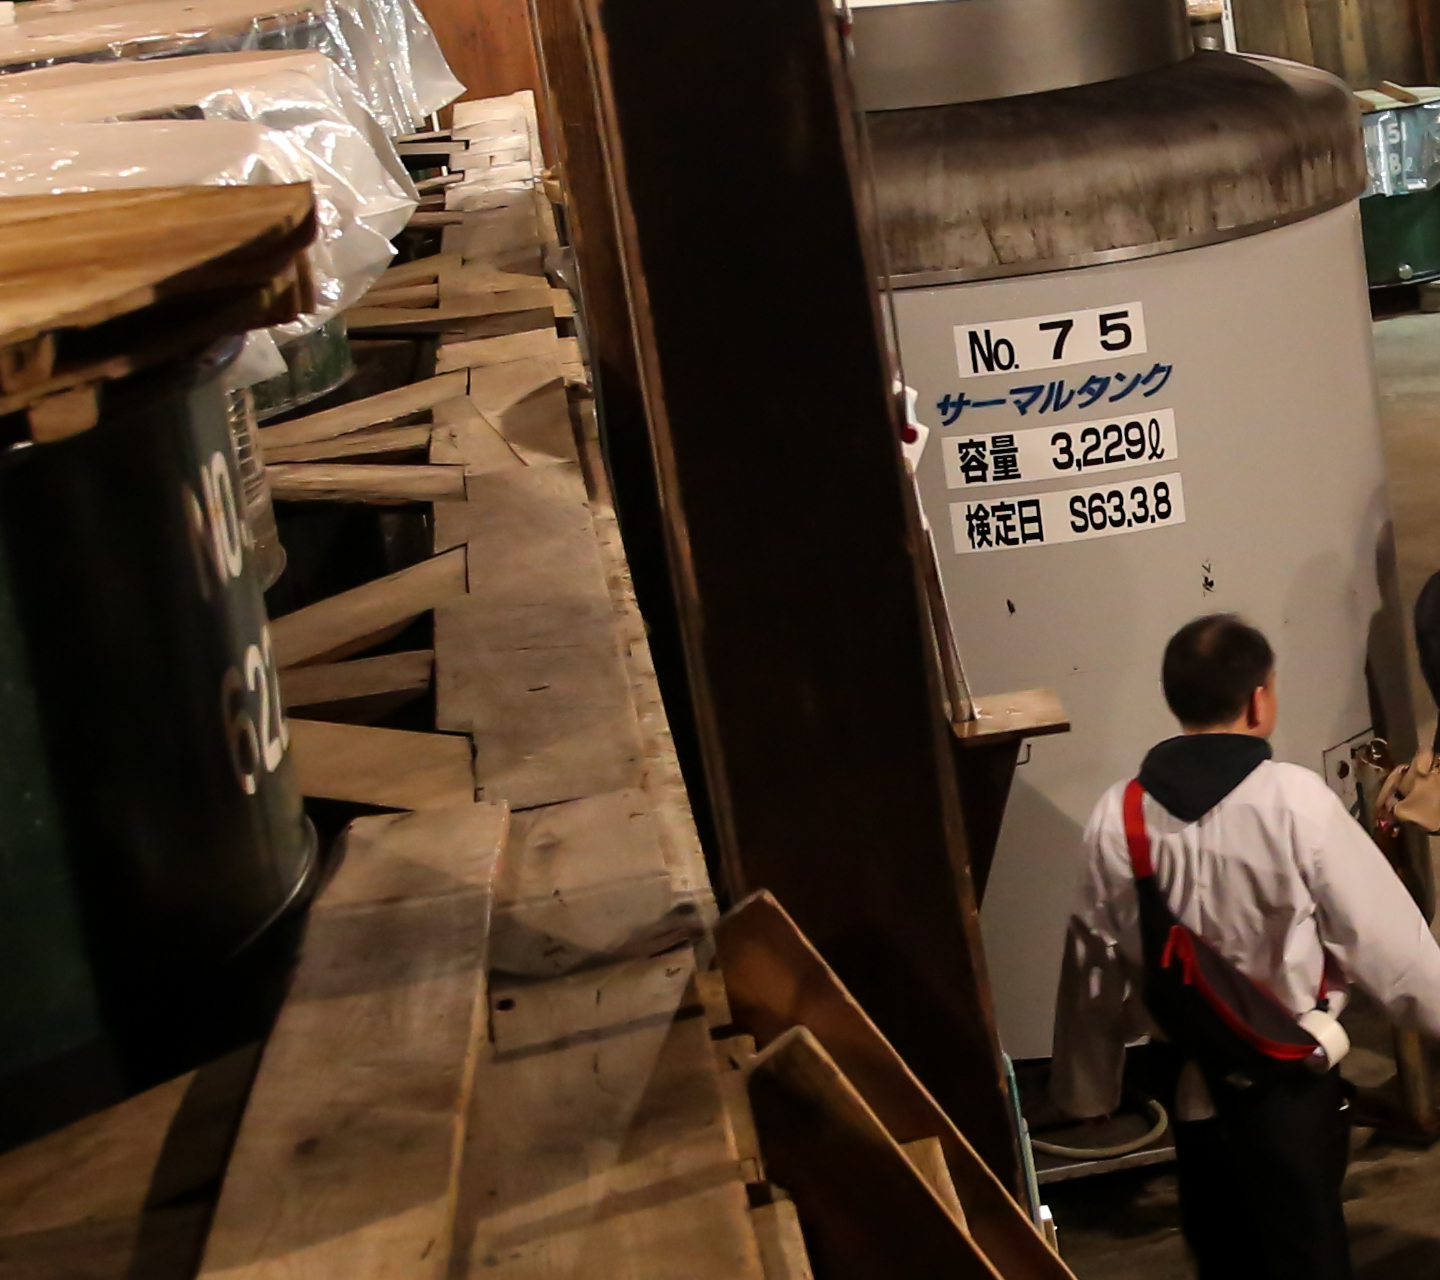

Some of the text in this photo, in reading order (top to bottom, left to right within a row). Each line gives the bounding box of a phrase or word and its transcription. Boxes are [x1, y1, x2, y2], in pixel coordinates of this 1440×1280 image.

[968, 329, 1020, 374] No.
[936, 362, 1173, 427] サーマルタンク
[957, 433, 1022, 484] 容量
[965, 481, 1172, 550] 検定日 S63.3.8
